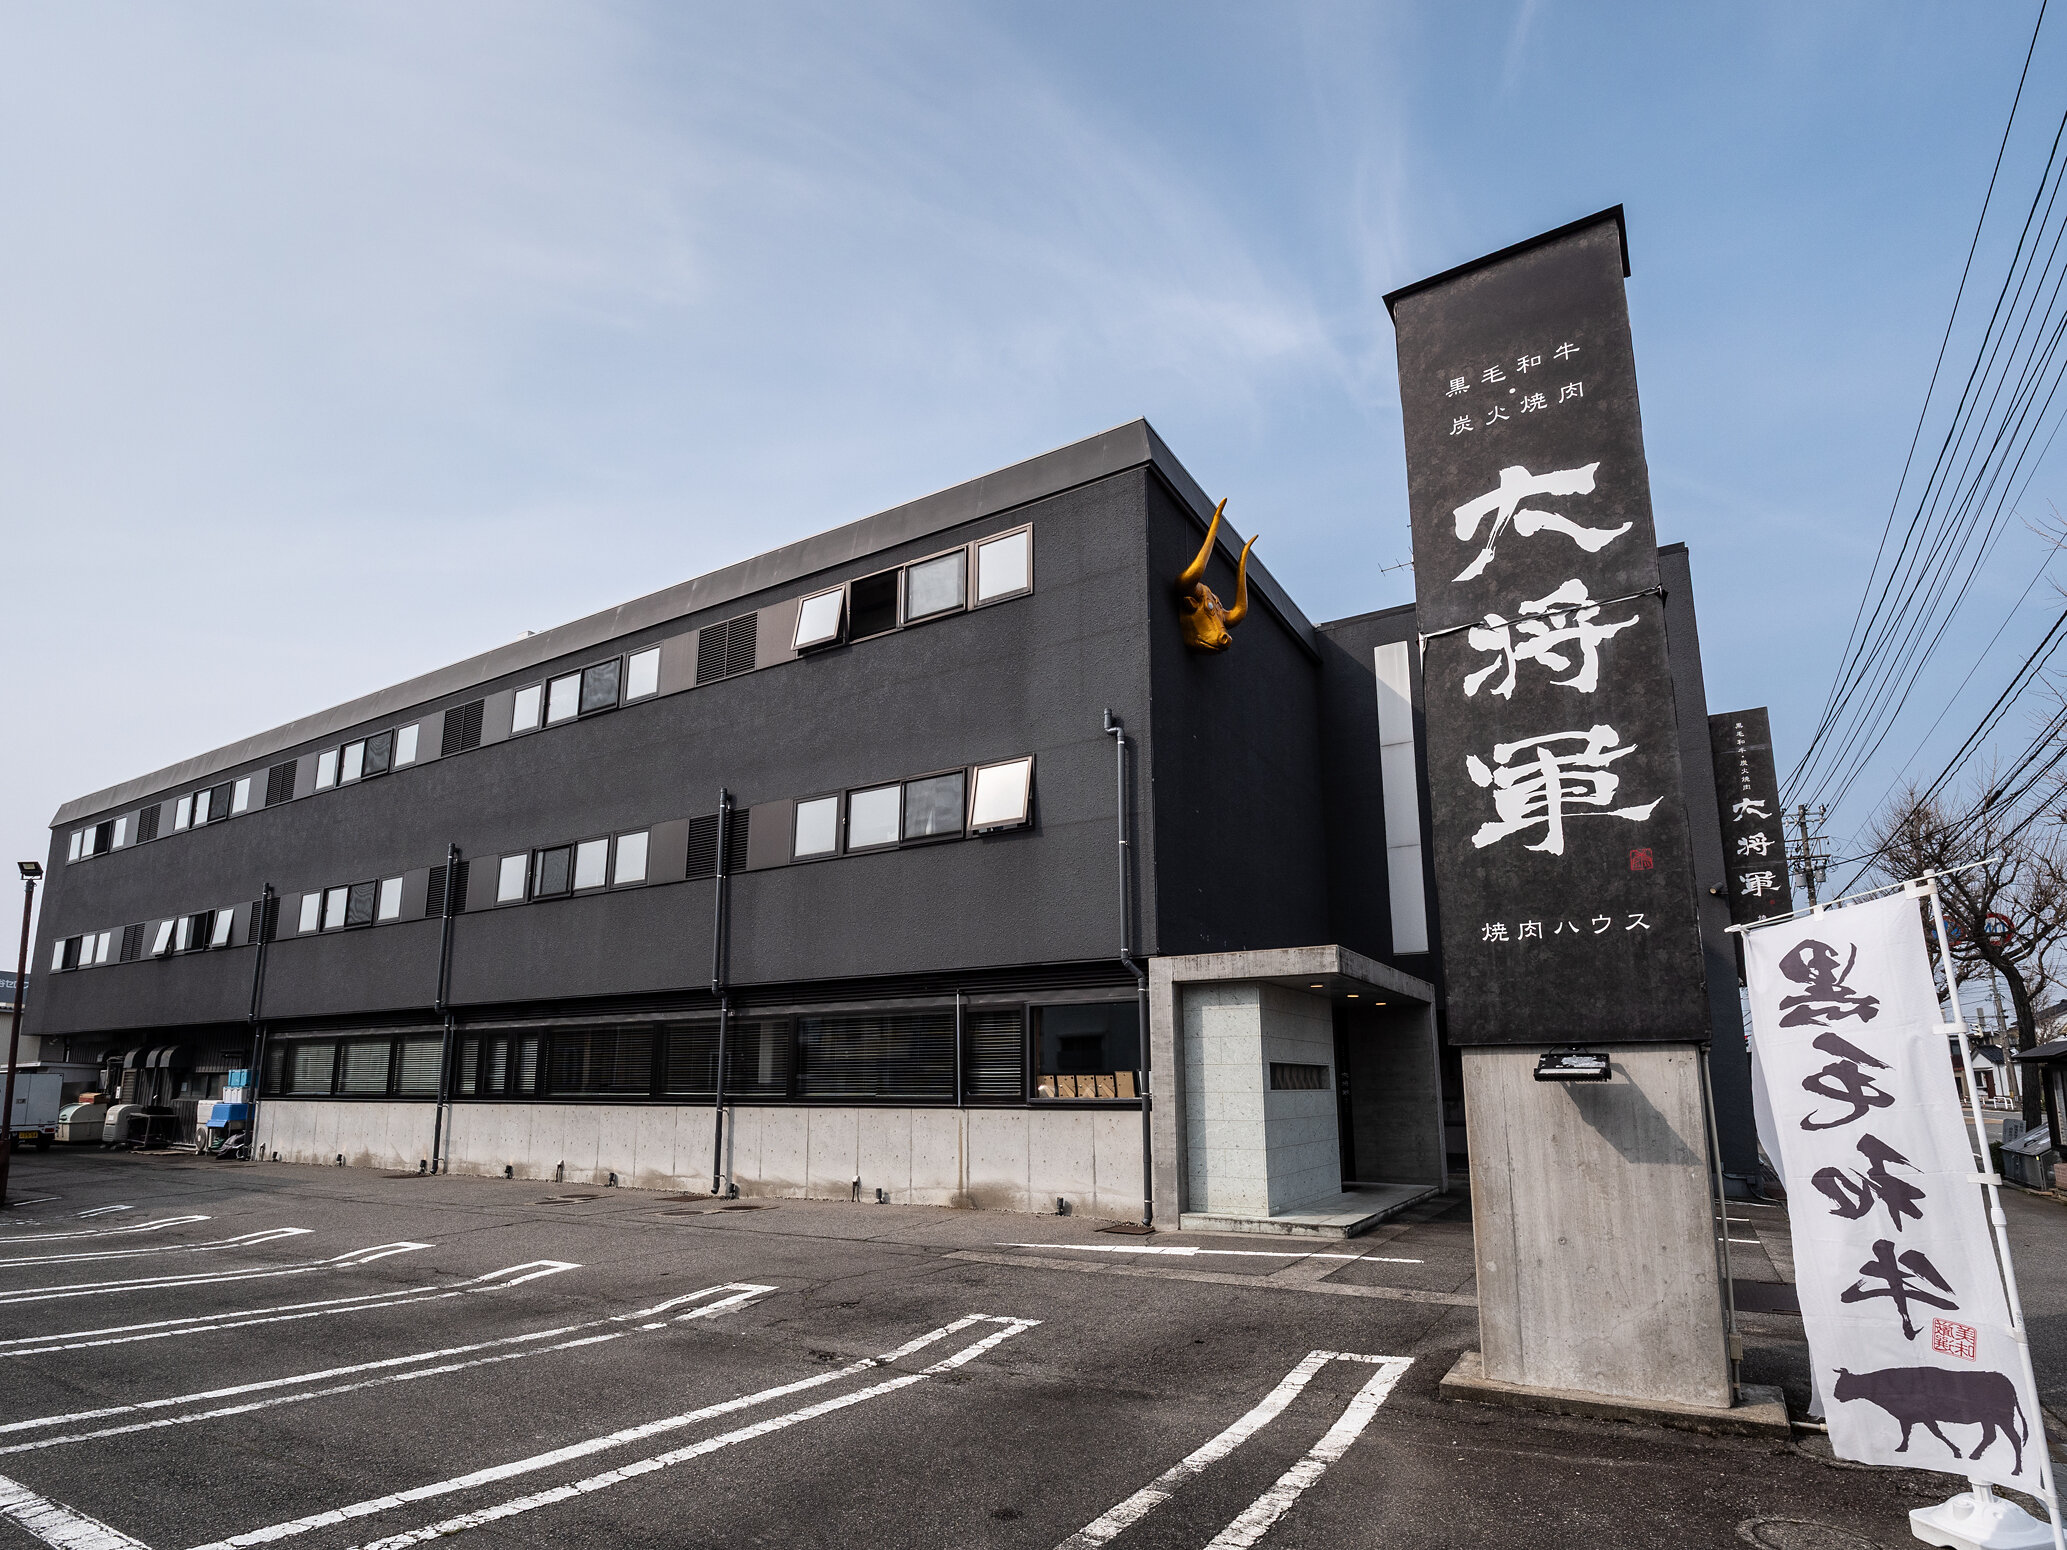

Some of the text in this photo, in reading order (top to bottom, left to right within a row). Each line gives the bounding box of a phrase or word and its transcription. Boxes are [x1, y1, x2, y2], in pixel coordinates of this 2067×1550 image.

[1445, 342, 1580, 398] 黒毛和牛
[1449, 382, 1584, 436] 炭火焼肉
[1452, 462, 1663, 856] 大将軍
[1732, 798, 1781, 897] 大将軍
[1482, 914, 1651, 944] 焼肉ハウス
